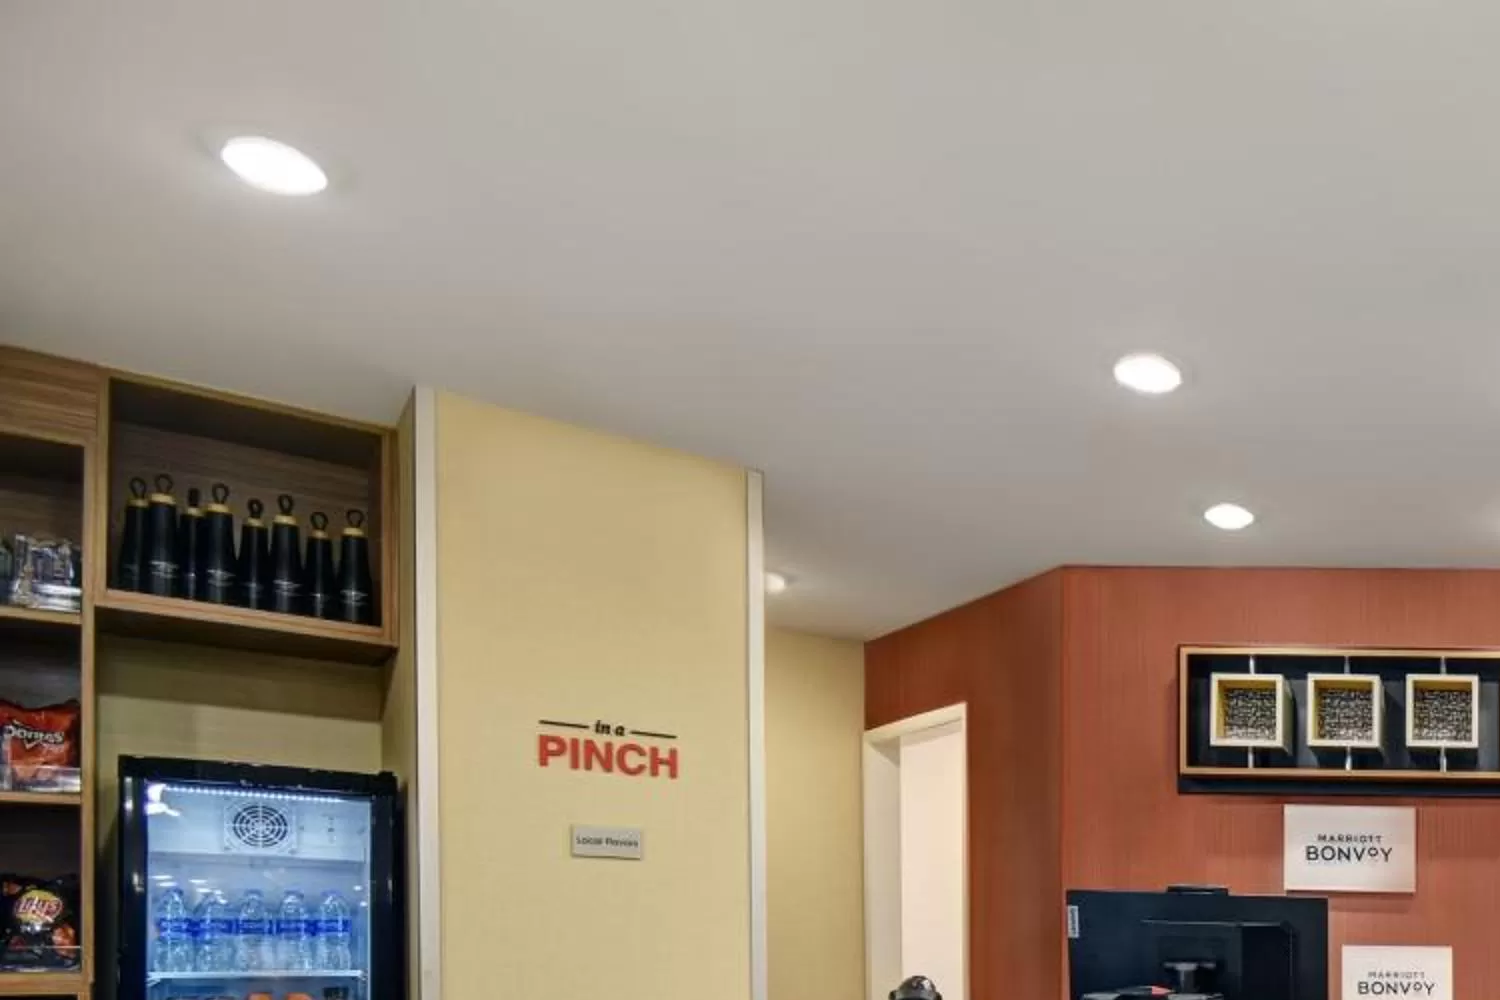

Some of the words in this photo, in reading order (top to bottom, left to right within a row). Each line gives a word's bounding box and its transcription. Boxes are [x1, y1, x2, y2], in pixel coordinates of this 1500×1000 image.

[594, 720, 611, 735] in
[615, 725, 625, 737] a
[538, 734, 678, 779] PINCH
[1317, 833, 1382, 843] MARRIOTT
[1305, 845, 1393, 862] BONVOY
[1367, 971, 1425, 979] MARRIOTT
[1357, 981, 1436, 996] BONVOY
